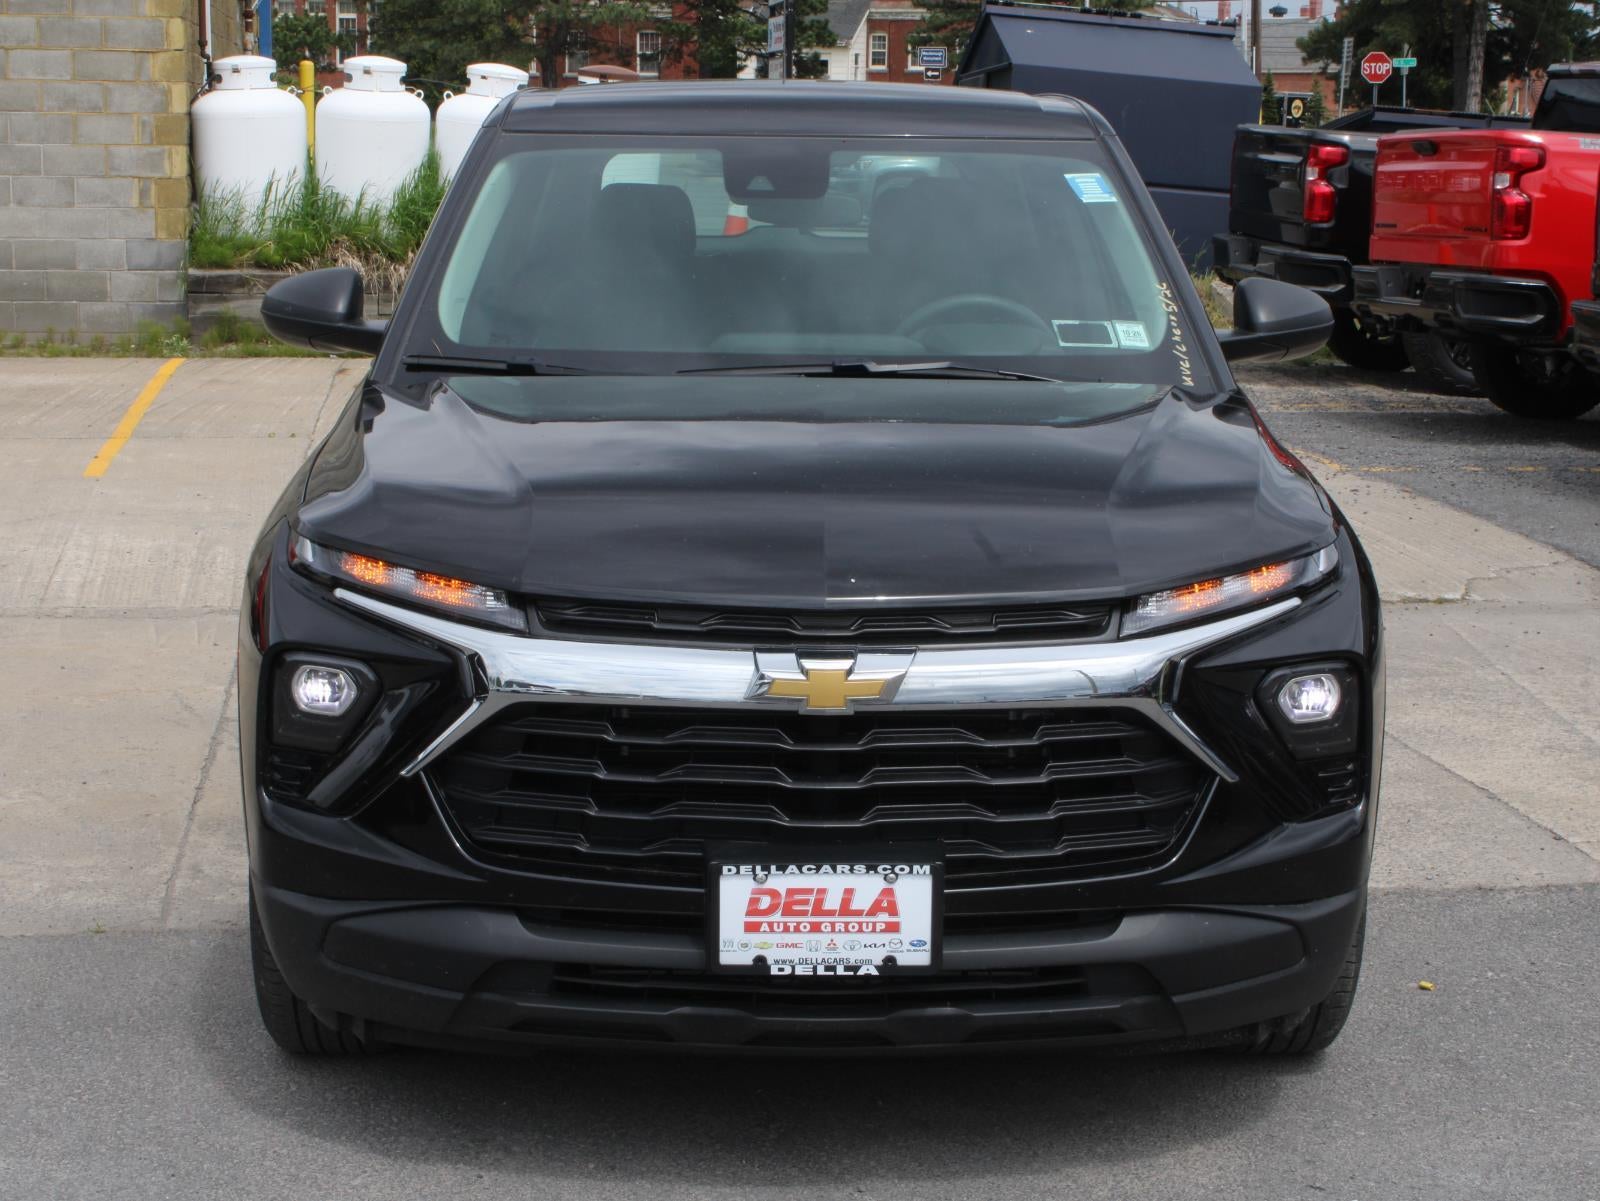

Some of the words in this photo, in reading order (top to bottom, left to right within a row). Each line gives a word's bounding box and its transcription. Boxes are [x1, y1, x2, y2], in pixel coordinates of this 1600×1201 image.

[1363, 63, 1390, 75] STOP
[722, 864, 931, 875] DELLACARS.COM
[744, 887, 900, 918] DELLA
[759, 922, 811, 933] AUTO
[821, 922, 887, 933] GROUP
[770, 964, 880, 976] DELLA
